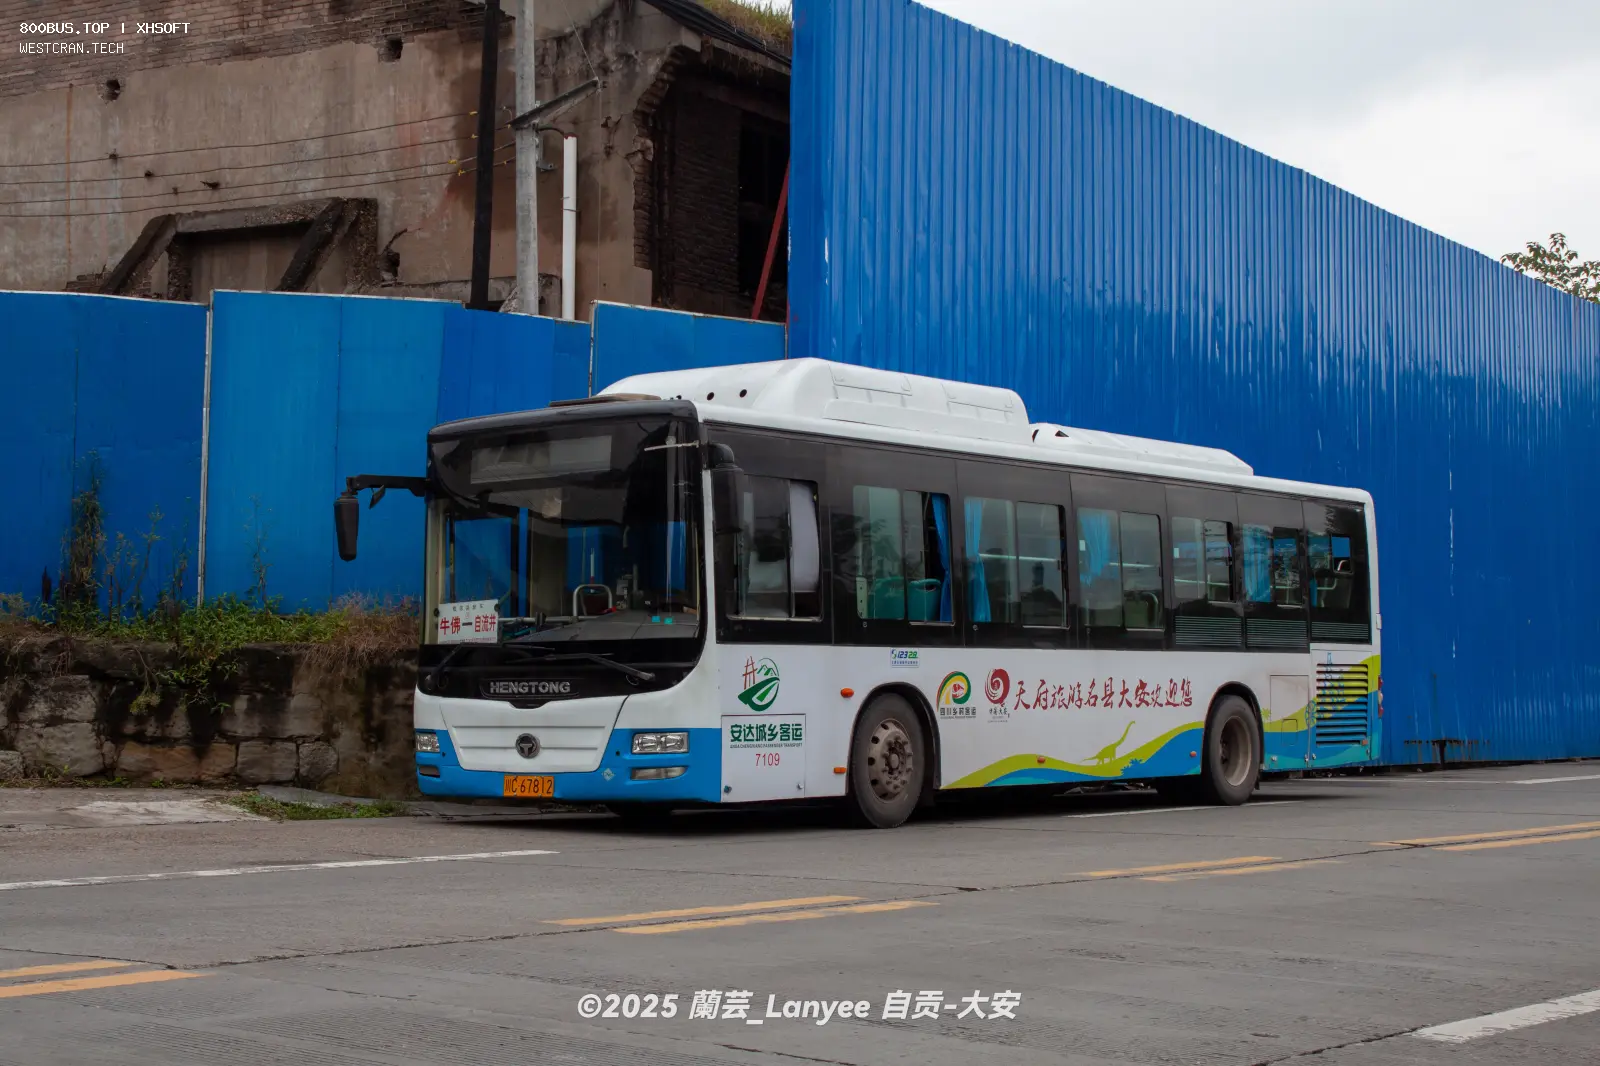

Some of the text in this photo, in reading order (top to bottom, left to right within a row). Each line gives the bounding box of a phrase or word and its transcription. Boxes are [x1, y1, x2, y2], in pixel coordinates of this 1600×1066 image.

[489, 681, 571, 694] HENGTONG
[1013, 676, 1193, 711] 天府旅游名县大安欢迎您
[730, 723, 803, 743] 安达城乡客运
[755, 752, 781, 767] 7109
